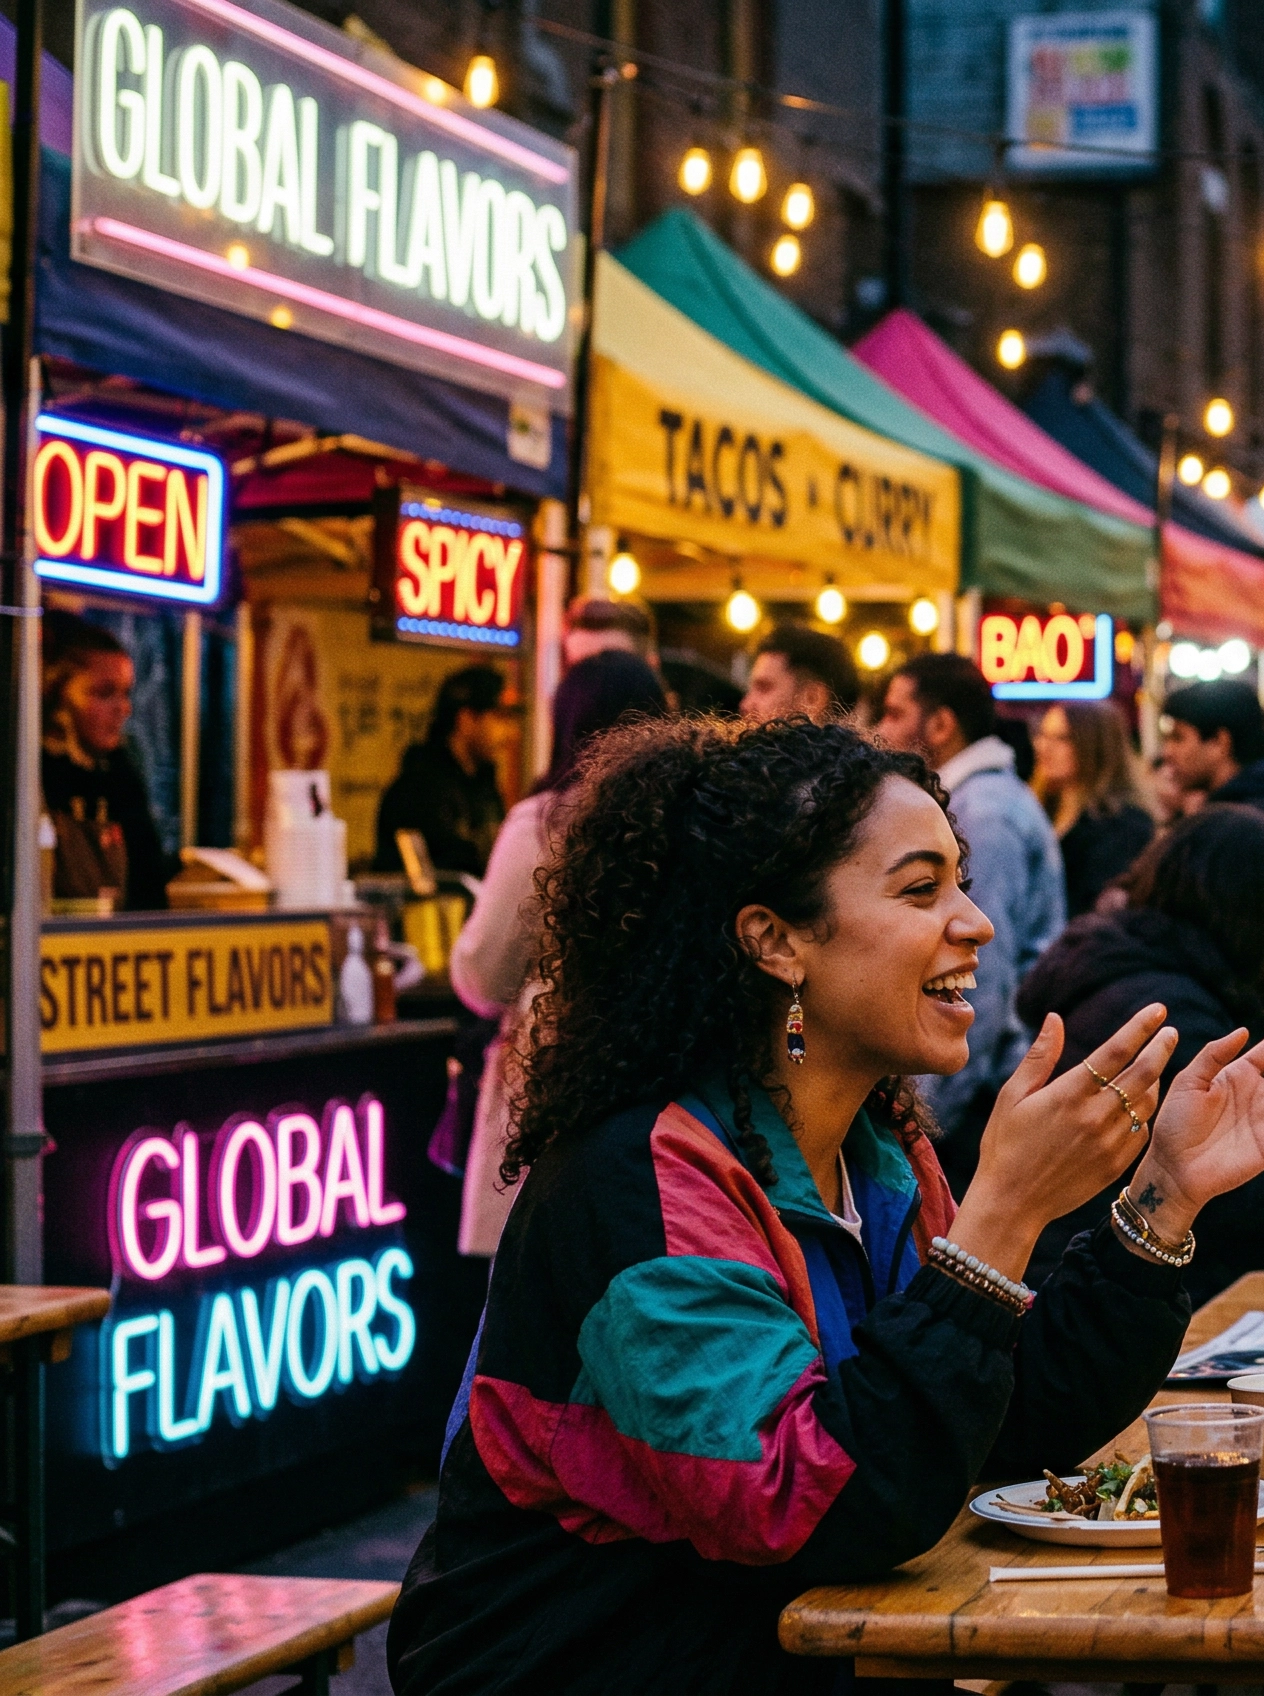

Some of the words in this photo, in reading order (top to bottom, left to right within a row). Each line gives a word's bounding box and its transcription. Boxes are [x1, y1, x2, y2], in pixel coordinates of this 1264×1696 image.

[98, 7, 334, 256] GLOBAL
[347, 119, 568, 344] FLAVORS
[34, 440, 209, 581] OPEN
[659, 407, 788, 529] TACOS
[834, 462, 935, 560] CURRY
[397, 520, 524, 627] SPICY
[40, 949, 174, 1029] STREET
[186, 941, 330, 1020] FLAVORS
[119, 1098, 407, 1281] GLOBAL
[111, 1247, 417, 1459] FLAVORS
